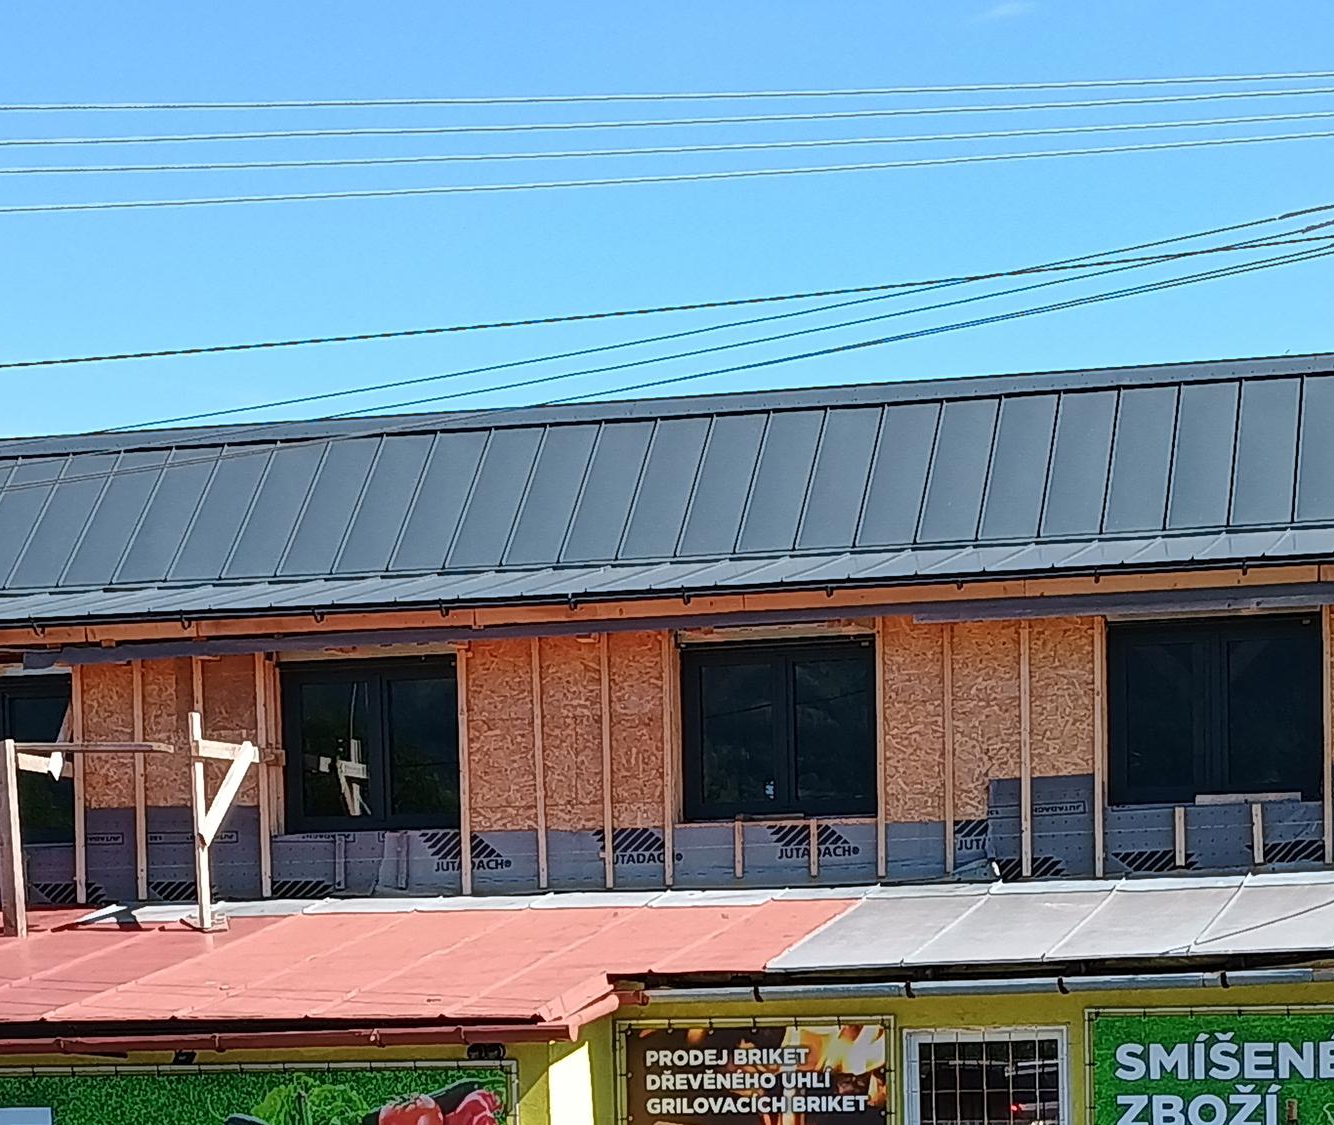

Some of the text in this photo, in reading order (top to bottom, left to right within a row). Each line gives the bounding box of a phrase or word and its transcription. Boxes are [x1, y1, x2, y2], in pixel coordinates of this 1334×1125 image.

[646, 1047, 809, 1067] PRODEJ BRIKET
[646, 1066, 830, 1091] DŘEVĚNÉHO UHLÍ
[646, 1091, 869, 1114] GRILOVACÍCH BRIKET
